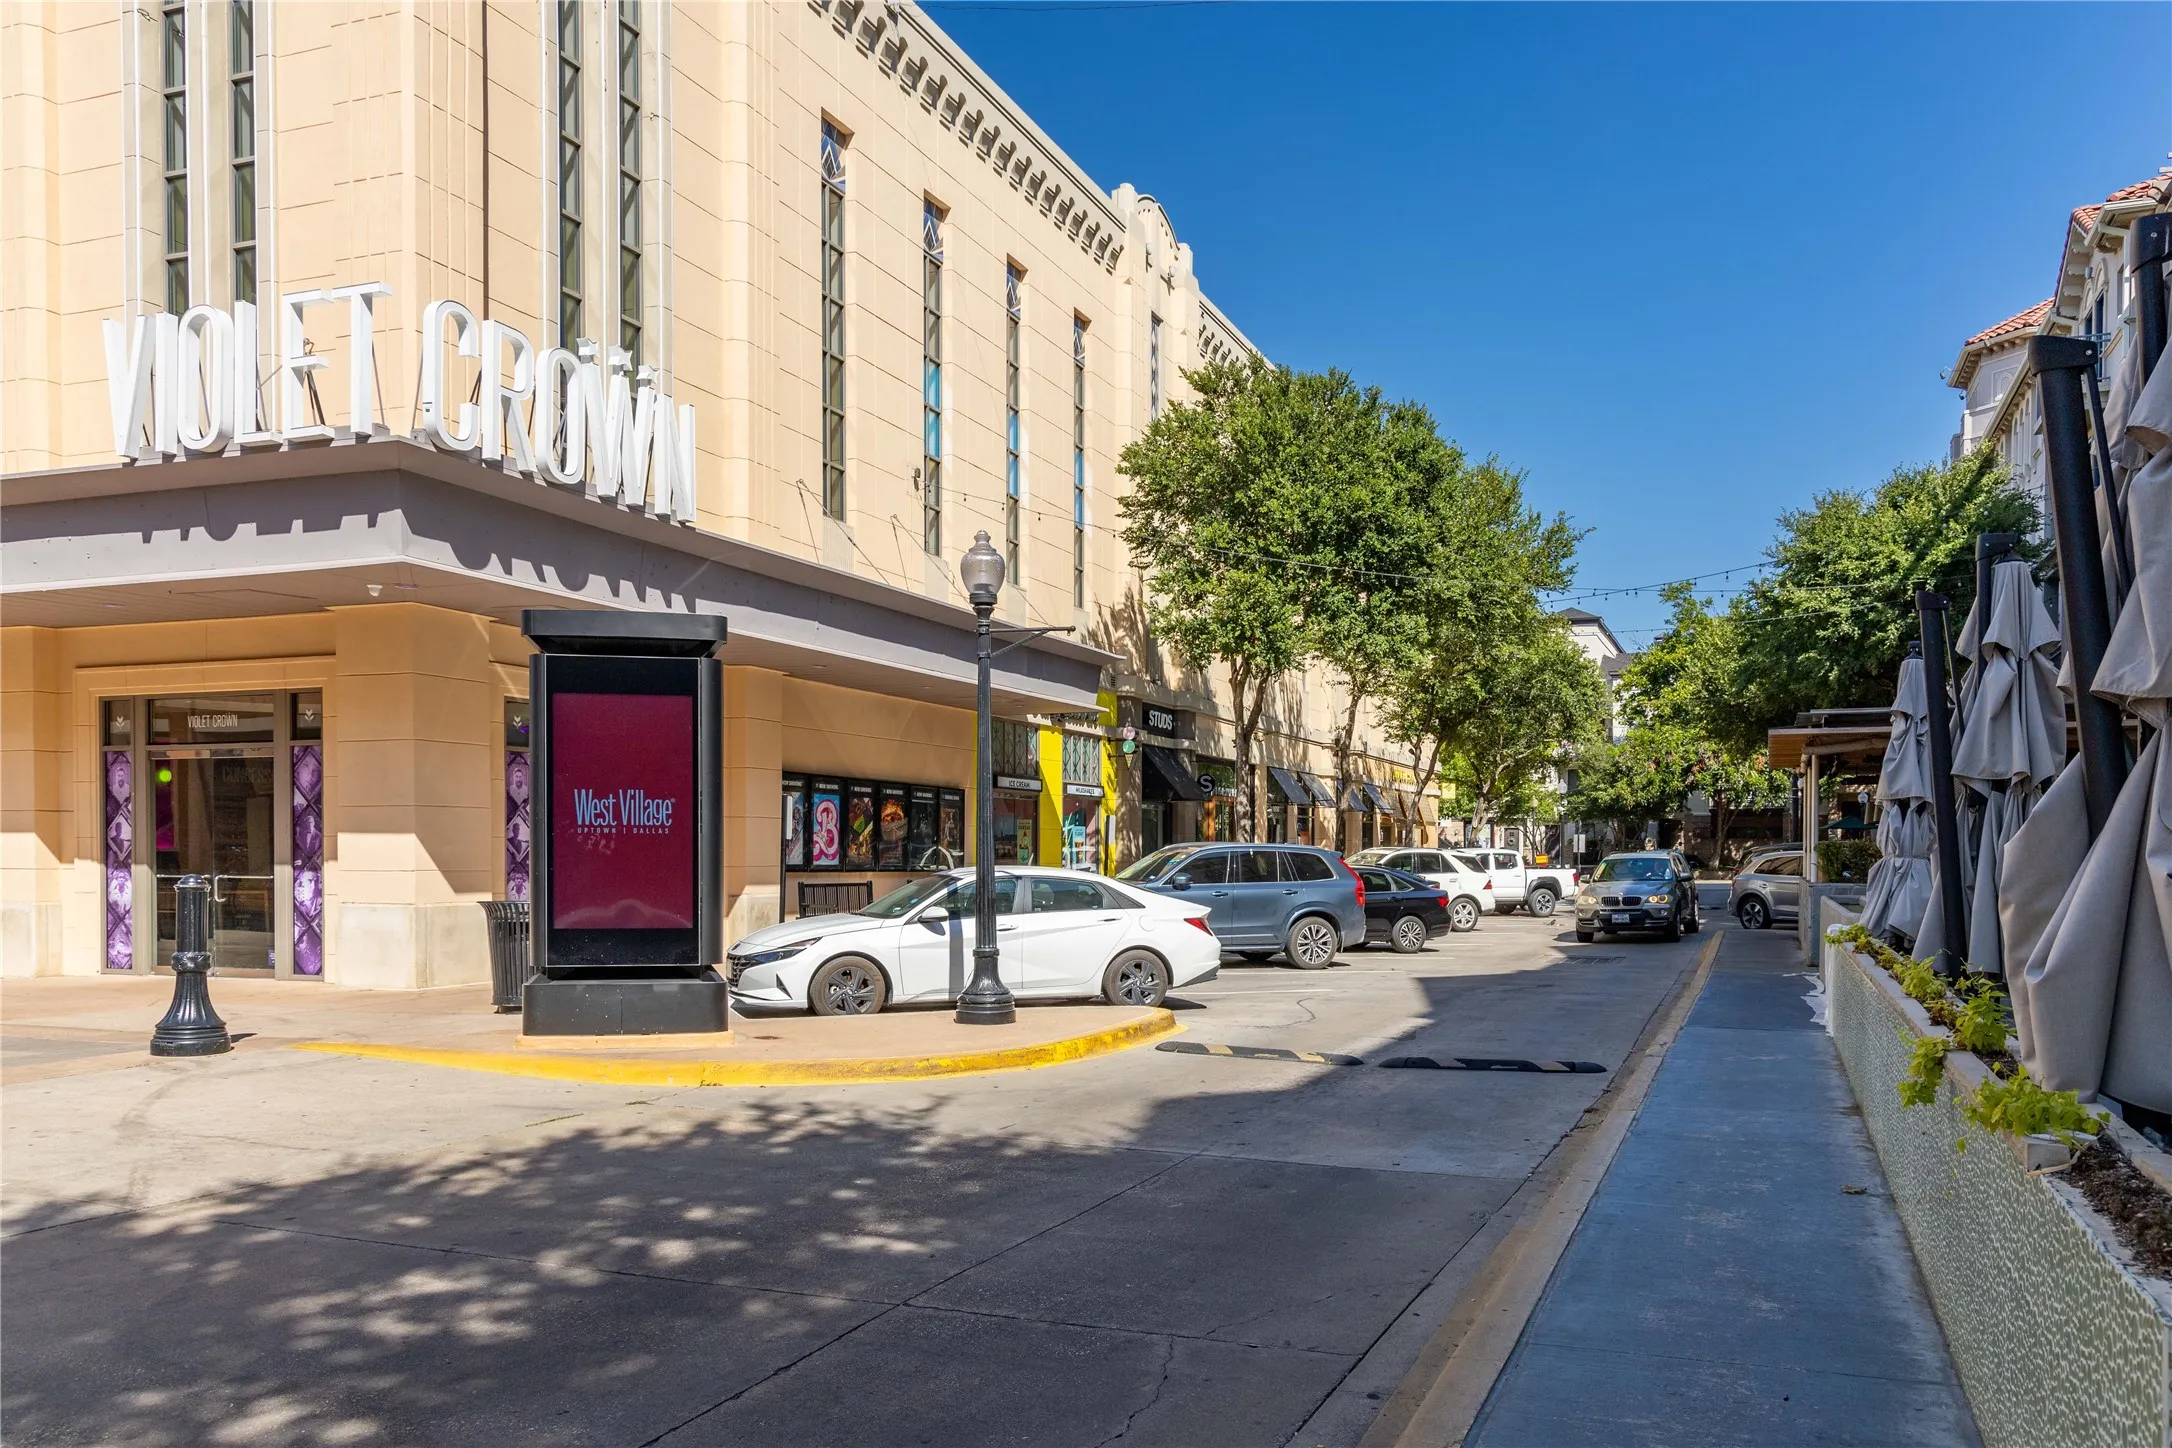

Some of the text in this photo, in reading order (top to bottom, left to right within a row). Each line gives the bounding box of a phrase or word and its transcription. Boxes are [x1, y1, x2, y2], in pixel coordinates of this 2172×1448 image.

[102, 280, 696, 524] VIOLET CROWN
[187, 712, 238, 728] VIOLET CROWN
[1148, 710, 1173, 730] STUDS
[1200, 775, 1213, 792] S
[574, 788, 617, 826] West
